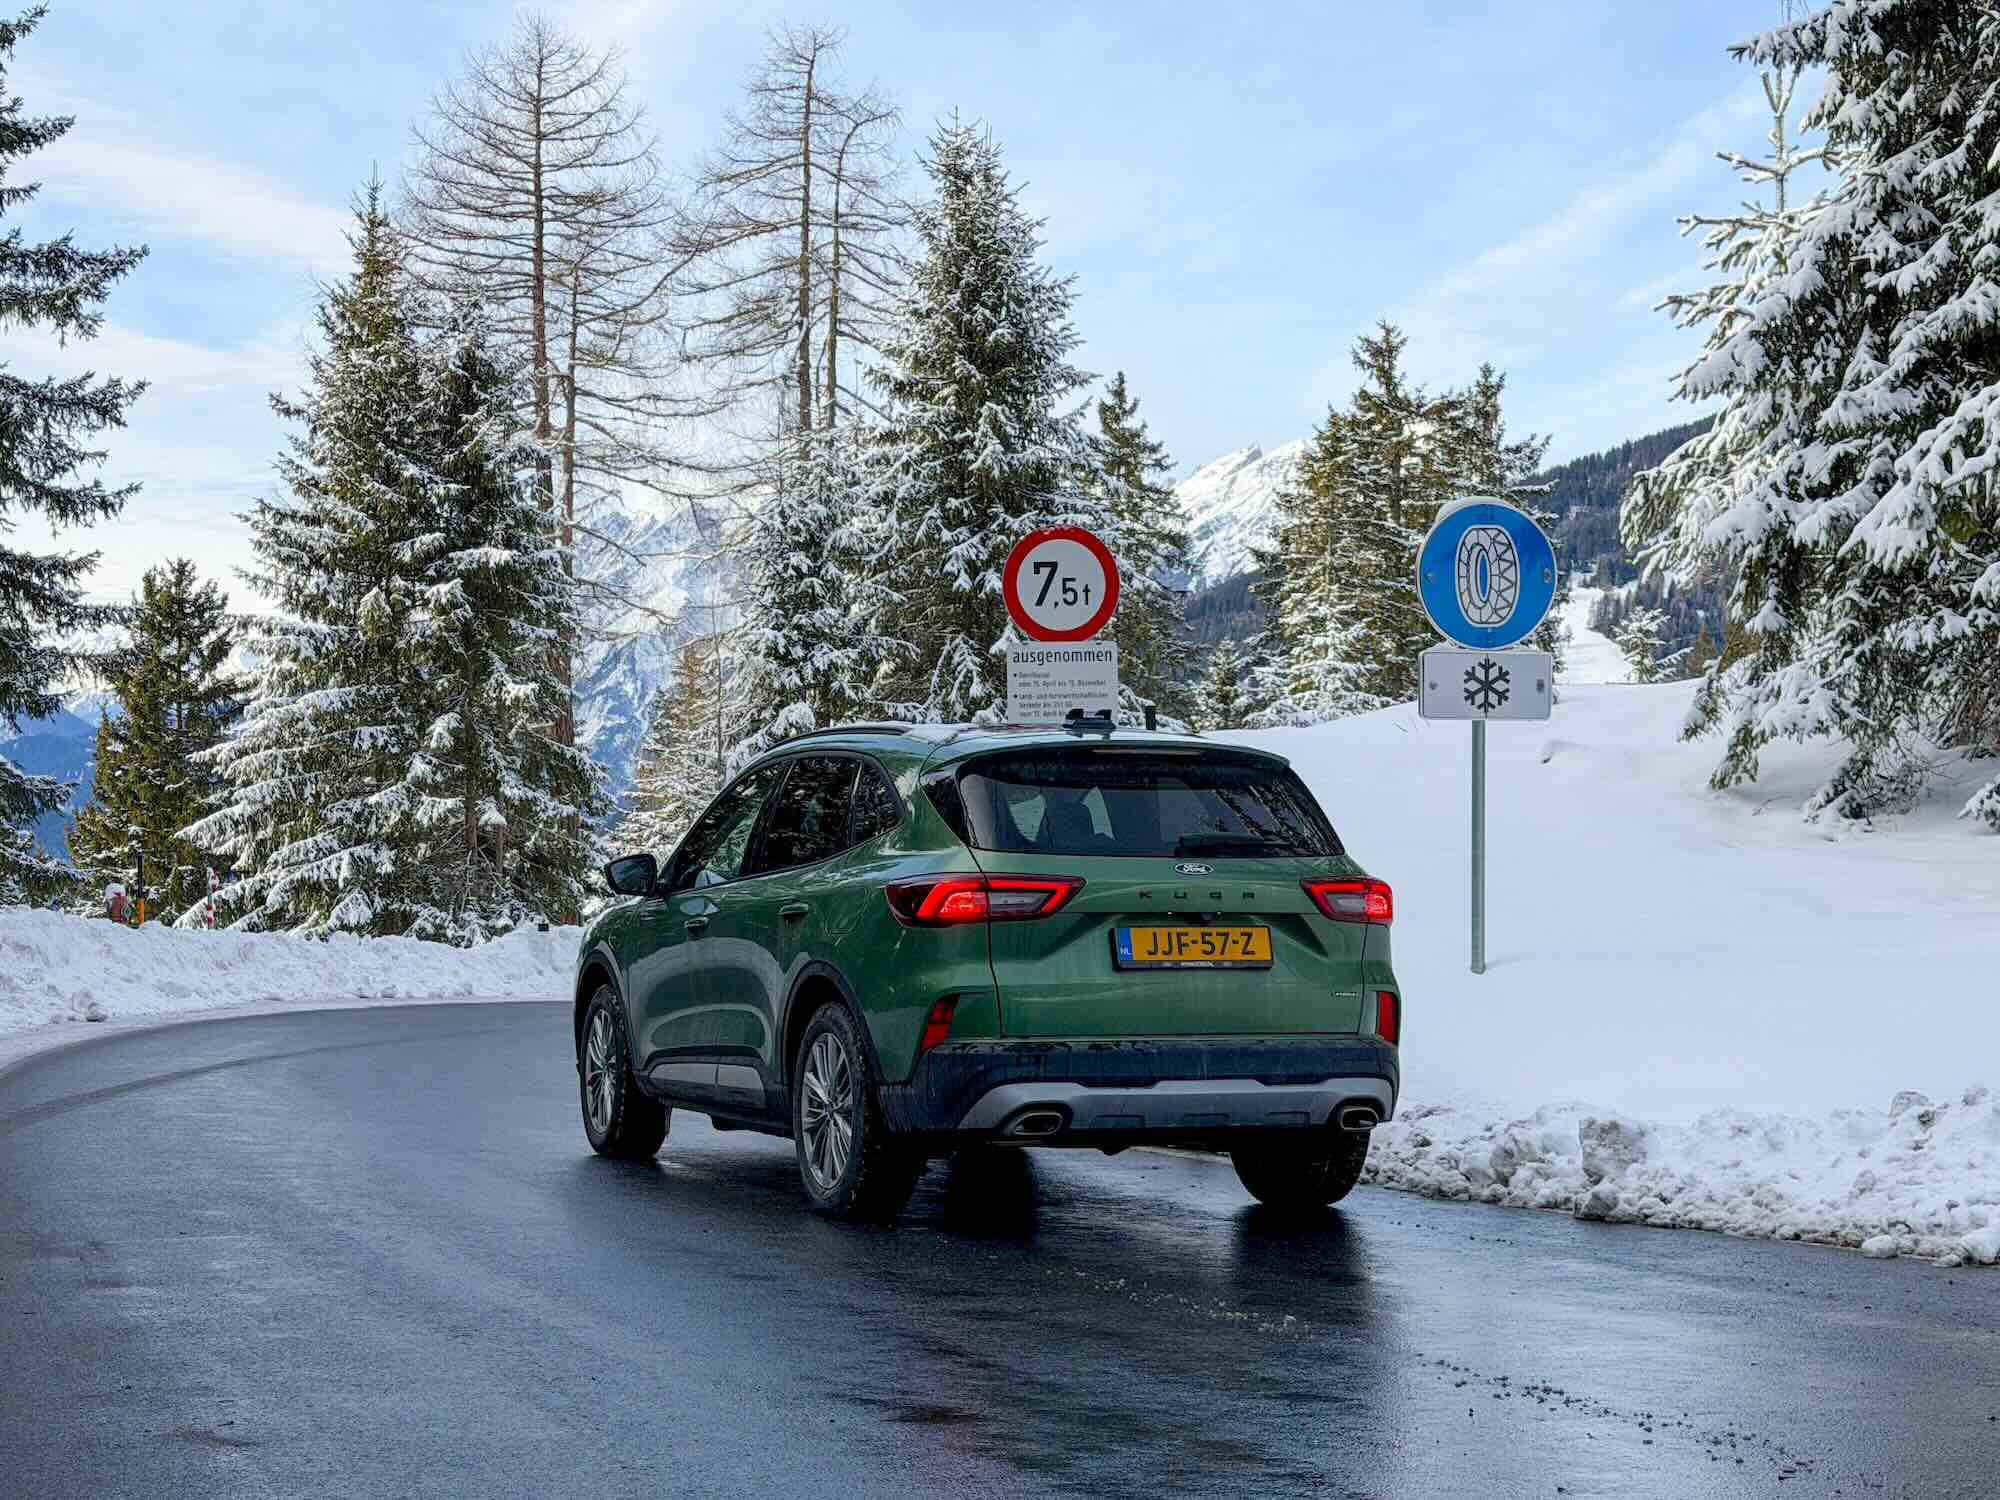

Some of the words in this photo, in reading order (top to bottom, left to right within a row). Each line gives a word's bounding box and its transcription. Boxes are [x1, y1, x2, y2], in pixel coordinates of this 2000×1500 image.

[1012, 650, 1112, 666] ausgenommen
[1138, 891, 1255, 900] KUGA
[1119, 947, 1132, 956] NL
[1146, 931, 1257, 956] JJF-57-Z
